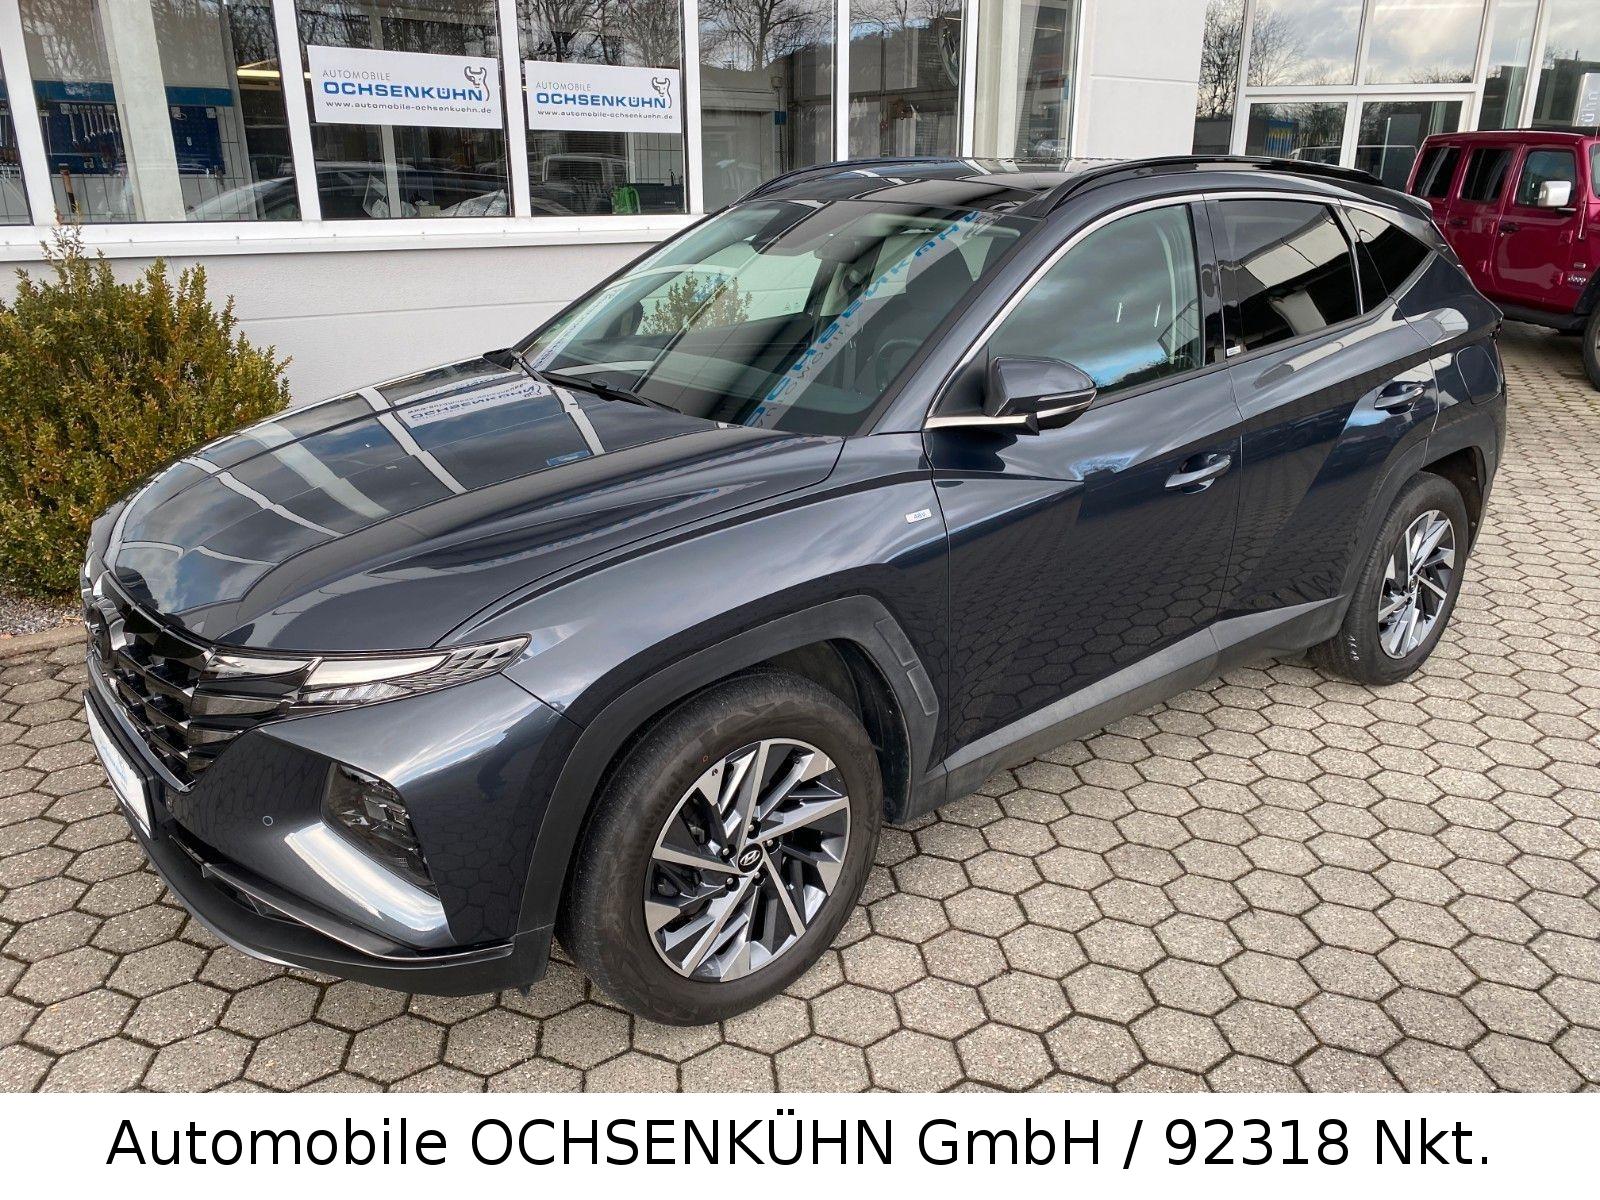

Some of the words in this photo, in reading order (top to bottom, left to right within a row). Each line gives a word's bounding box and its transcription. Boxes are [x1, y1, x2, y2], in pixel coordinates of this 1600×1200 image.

[322, 69, 391, 81] AUTOMOBILE
[323, 81, 483, 102] OCHSENKÜHN
[535, 81, 592, 91] AUTOMOBILE
[536, 92, 666, 109] OCHSENKÜHN
[325, 101, 492, 114] www.automobile-ochsenkuehn.de
[537, 110, 673, 120] www.automobile-ochsenkuehn.de
